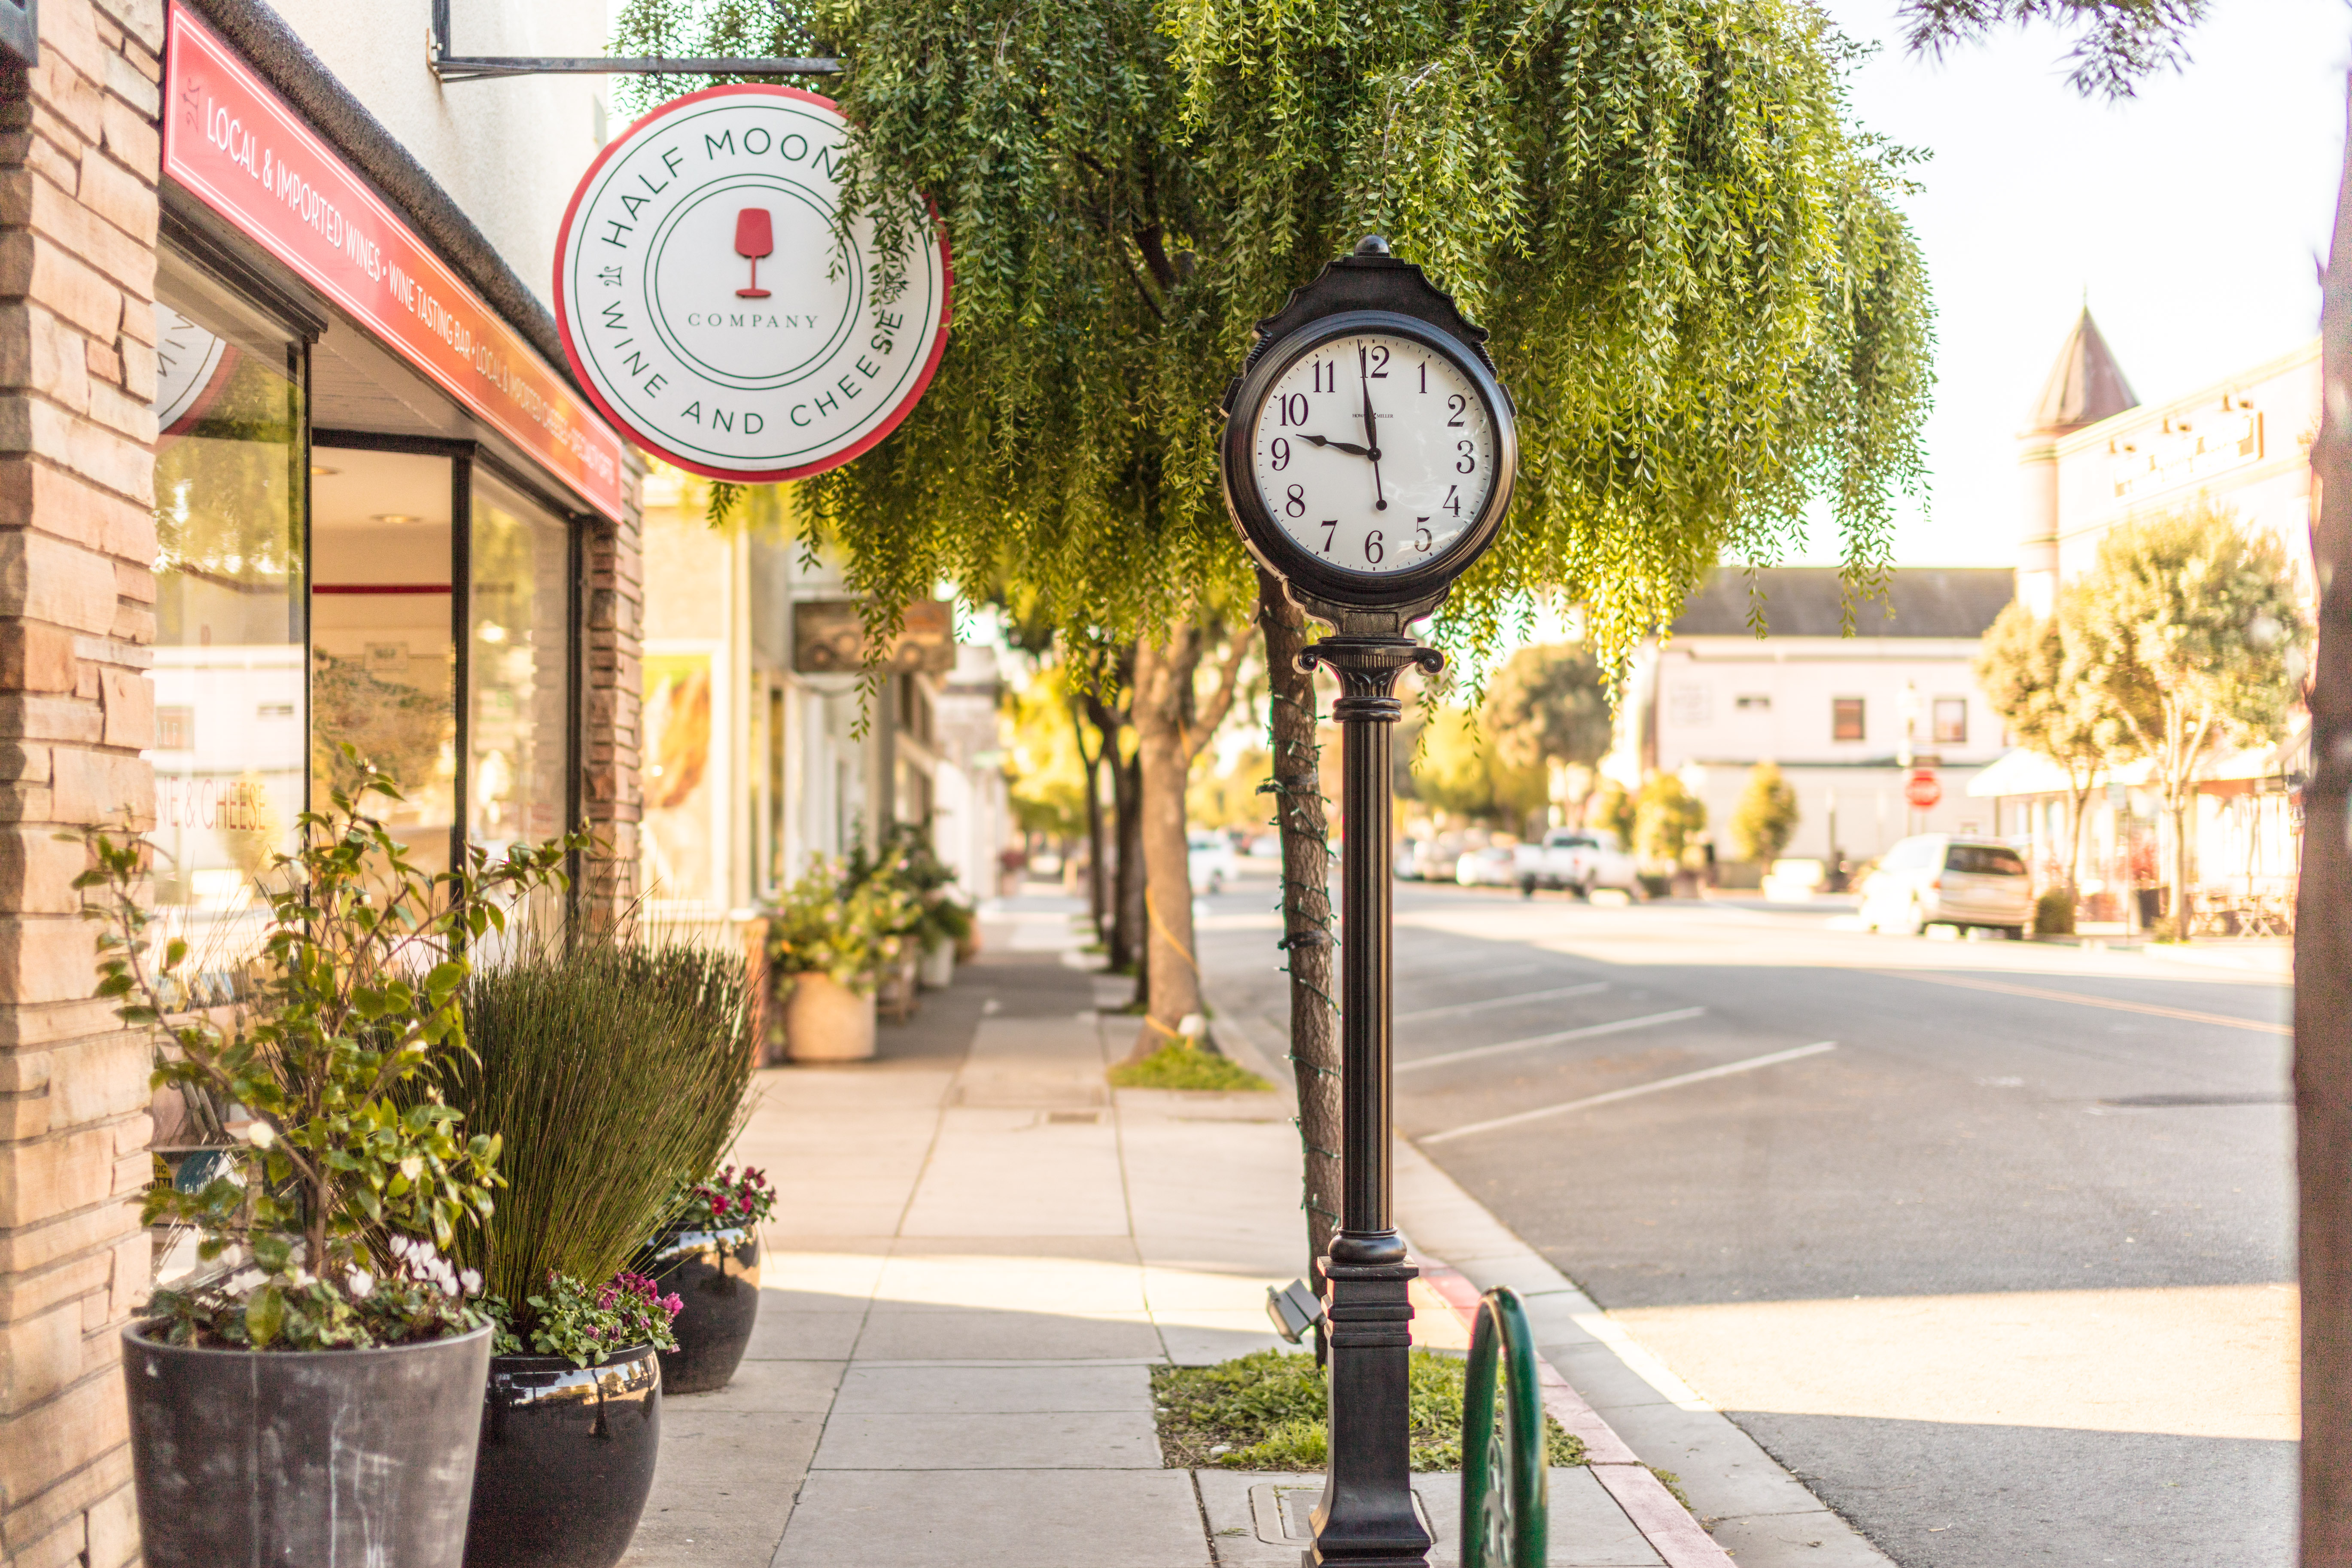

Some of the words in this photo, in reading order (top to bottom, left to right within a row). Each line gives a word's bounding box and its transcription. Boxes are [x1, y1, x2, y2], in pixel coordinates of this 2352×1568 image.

[602, 146, 684, 249] HALF
[704, 128, 843, 179] MOON
[207, 97, 259, 180] LOCAL
[263, 148, 273, 192] &
[277, 159, 342, 248] IMPORTED
[346, 220, 380, 283] WINES
[389, 260, 414, 314] WINE
[416, 286, 453, 346] TASTING
[455, 319, 471, 362] BAR
[688, 312, 820, 329] COMPANY
[602, 301, 668, 398] WINE
[681, 401, 764, 435] AND
[790, 309, 903, 427] CHEESE
[1312, 359, 1336, 393] 11
[1360, 345, 1390, 379] 12
[1418, 360, 1427, 394] 1
[1278, 393, 1308, 426] 10
[1447, 394, 1467, 427] 2
[1271, 437, 1290, 471] 9
[1456, 440, 1476, 474] 3
[1285, 484, 1306, 518] 8
[1442, 484, 1461, 518] 4
[1320, 519, 1338, 552] 7
[1364, 530, 1384, 563] 6
[1414, 516, 1433, 552] 5
[155, 721, 178, 746] ALF
[155, 775, 178, 828] NE
[184, 781, 196, 829] &
[201, 778, 265, 831] CHEESE
